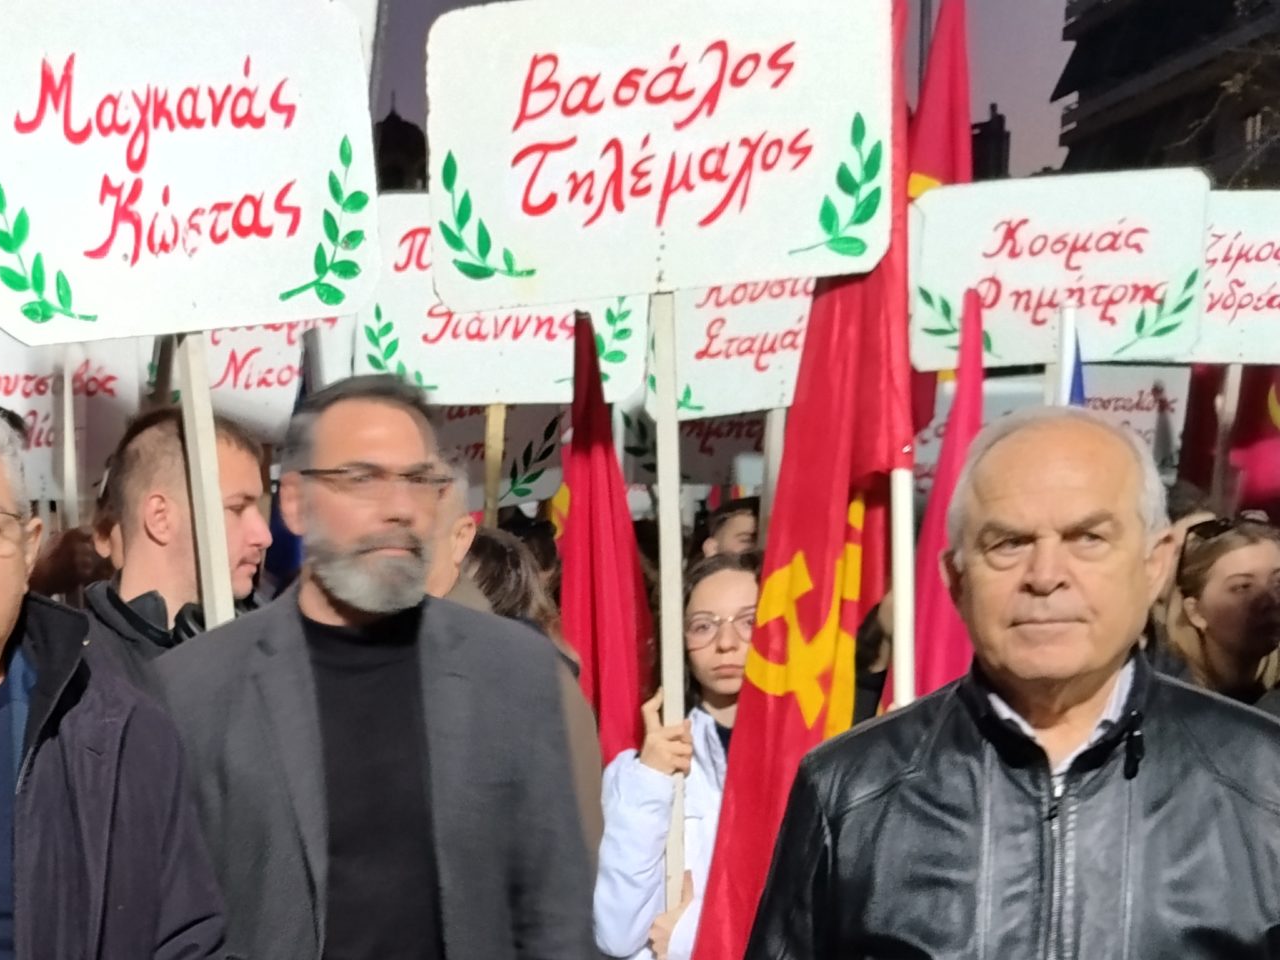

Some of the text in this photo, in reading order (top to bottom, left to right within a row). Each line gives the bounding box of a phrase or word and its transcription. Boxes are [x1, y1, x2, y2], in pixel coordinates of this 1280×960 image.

[14, 54, 296, 173] Μαγκανάς
[512, 40, 796, 131] Βασάλος
[83, 174, 302, 265] Κώστας
[511, 129, 813, 226] Τηλέμαχος
[982, 217, 1150, 271] Κοσμάς
[1205, 226, 1280, 277] ζίμο
[1204, 279, 1280, 325] νδρέα
